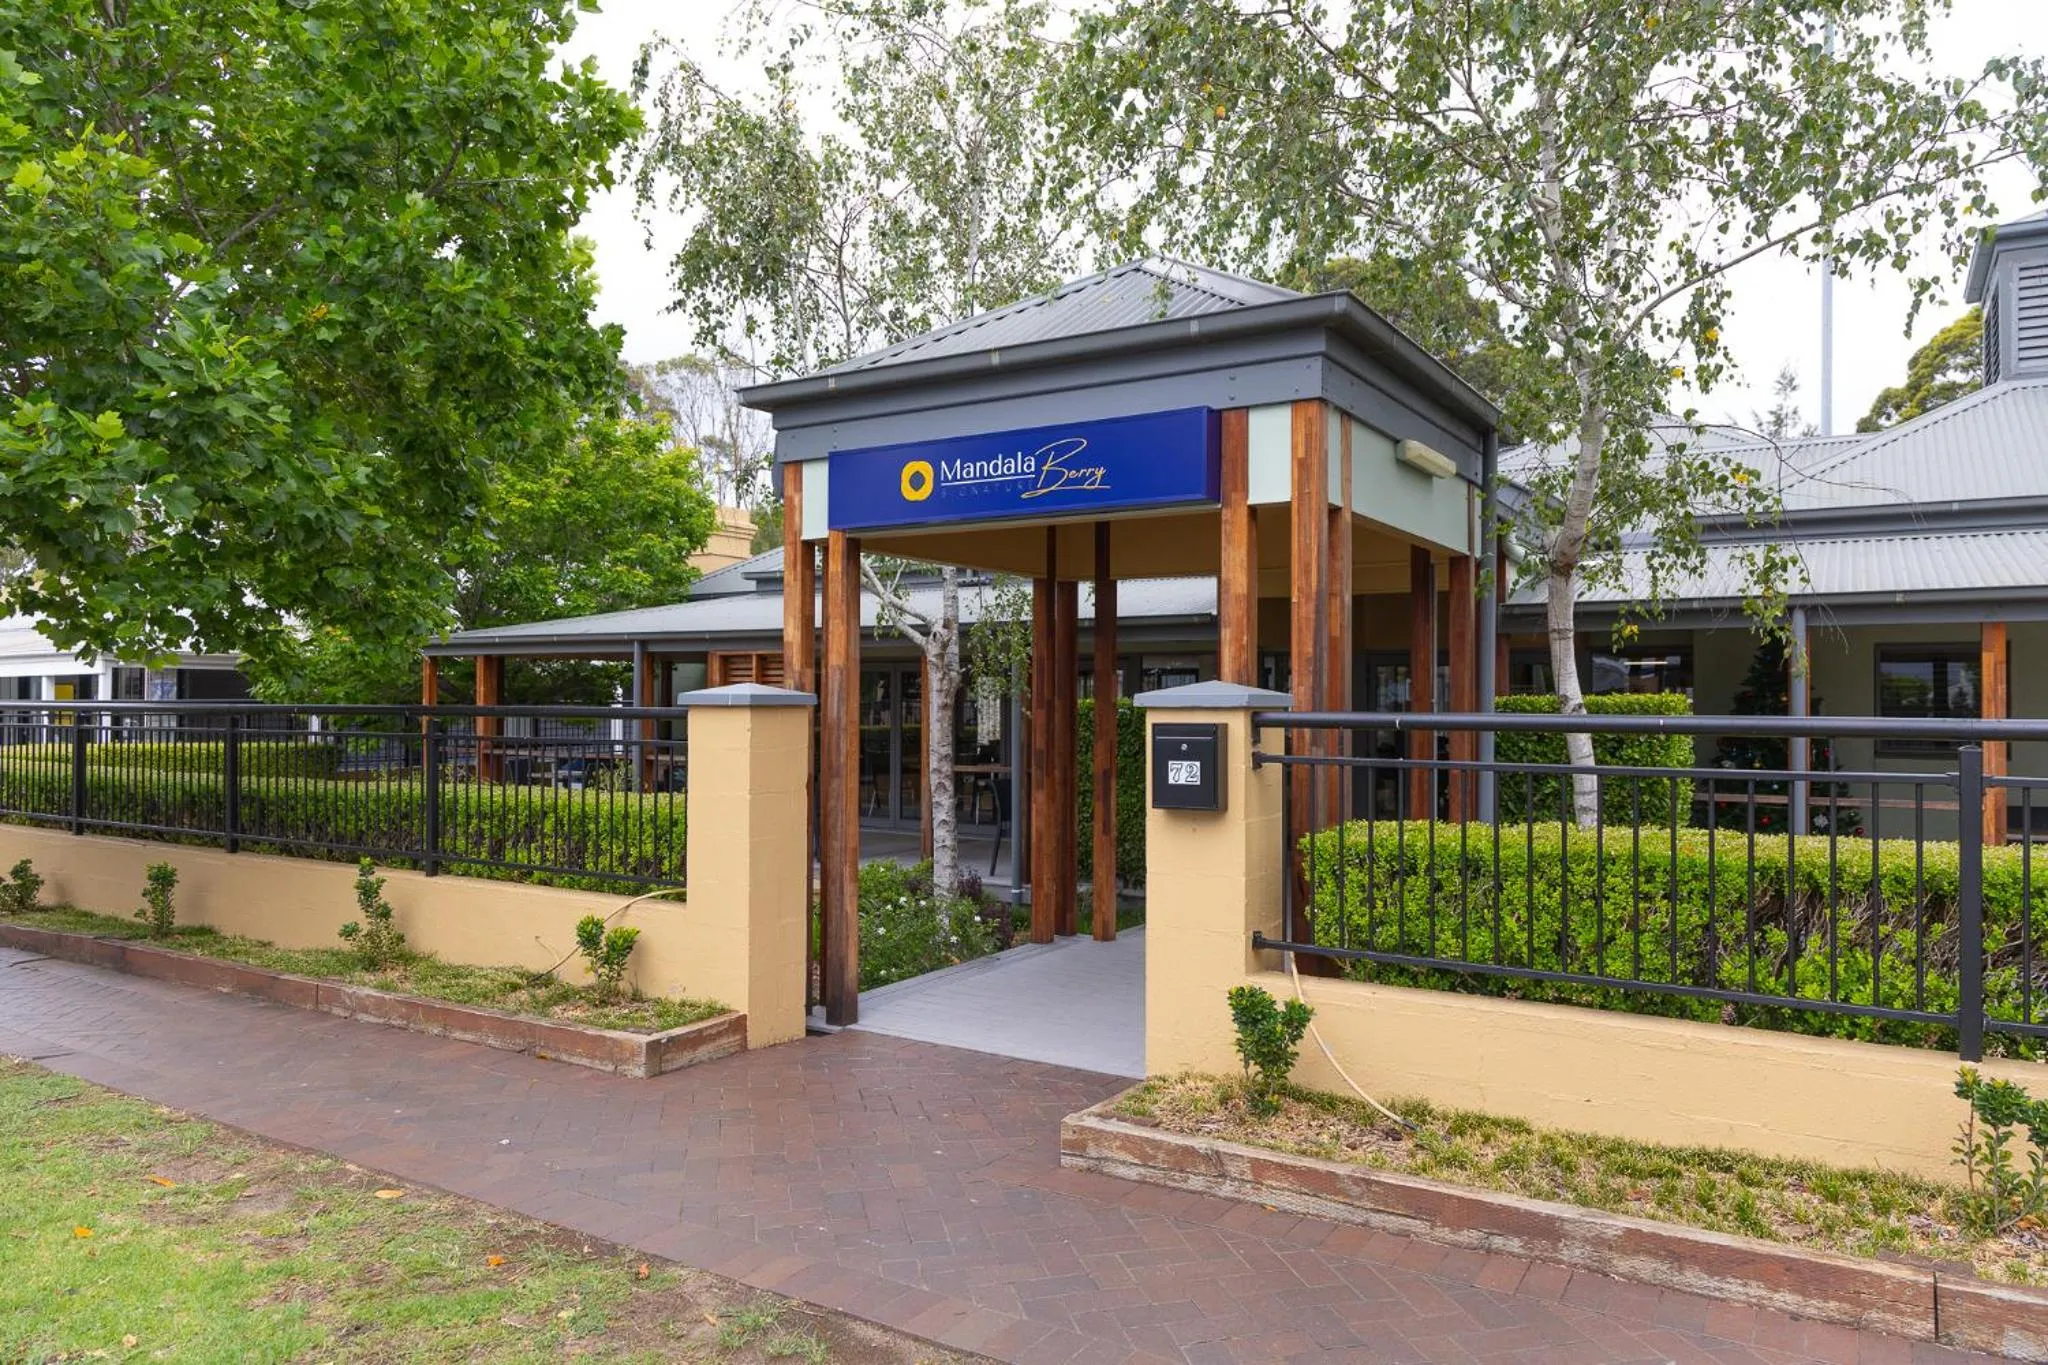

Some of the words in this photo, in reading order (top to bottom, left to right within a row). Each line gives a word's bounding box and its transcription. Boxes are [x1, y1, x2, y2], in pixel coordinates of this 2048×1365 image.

[940, 451, 1036, 481] Mandala
[1021, 437, 1111, 499] Berry
[940, 480, 1034, 499] SGNATURE
[1169, 762, 1200, 783] 72
